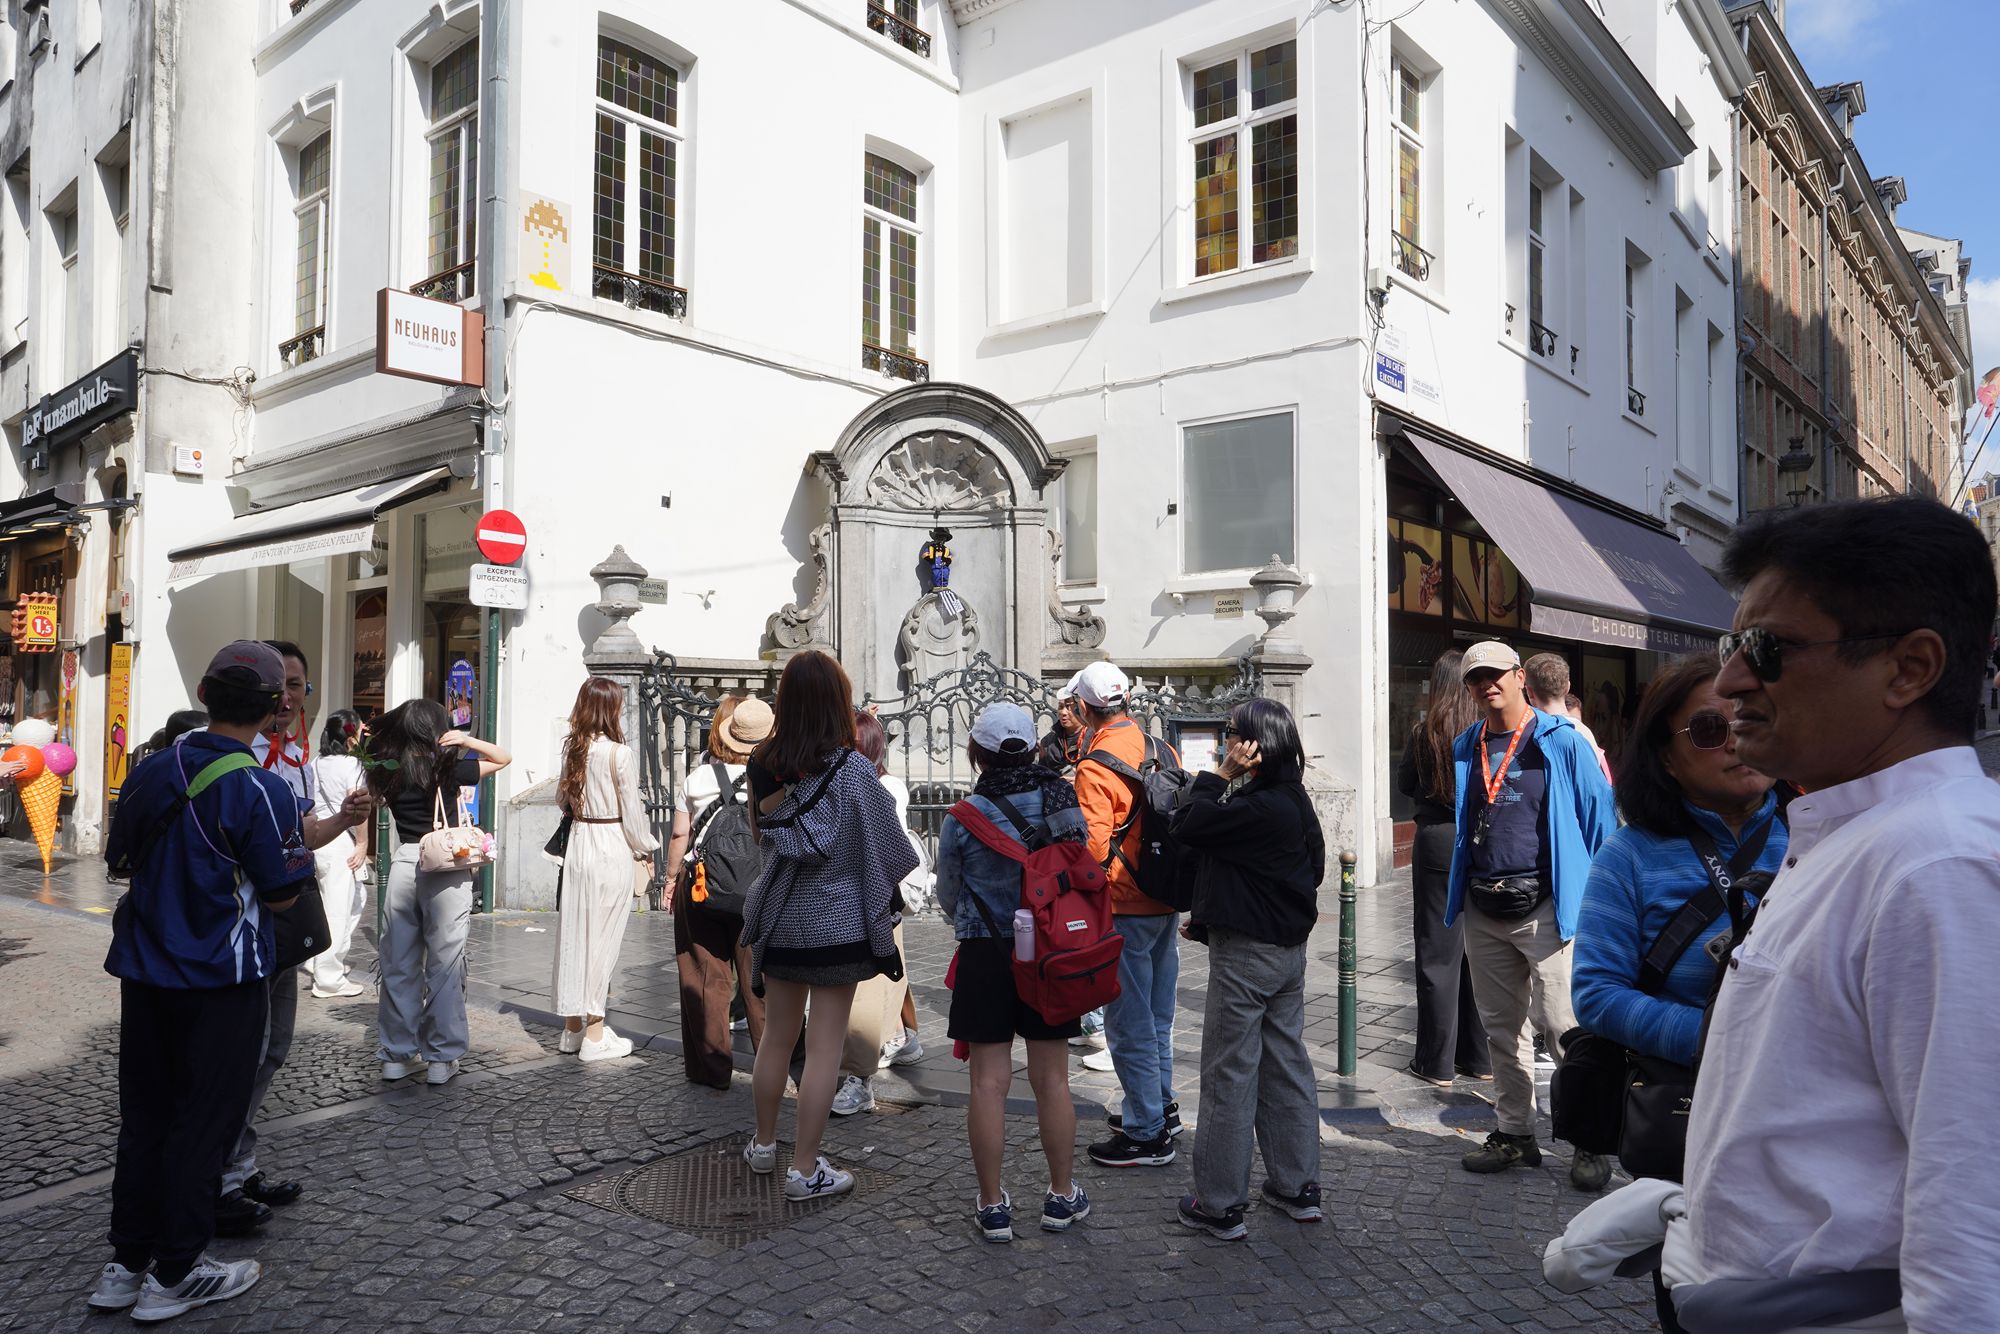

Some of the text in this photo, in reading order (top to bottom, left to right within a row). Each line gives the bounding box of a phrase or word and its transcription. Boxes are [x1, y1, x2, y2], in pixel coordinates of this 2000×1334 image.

[395, 318, 457, 347] NEUHAUS
[252, 548, 284, 560] INVENTOR
[282, 546, 293, 557] OF
[293, 542, 307, 554] THE
[306, 538, 336, 552] BELGIAN
[476, 574, 528, 585] UITGEZONDERD
[640, 582, 665, 591] CAMERA
[1704, 854, 1732, 895] ONY
